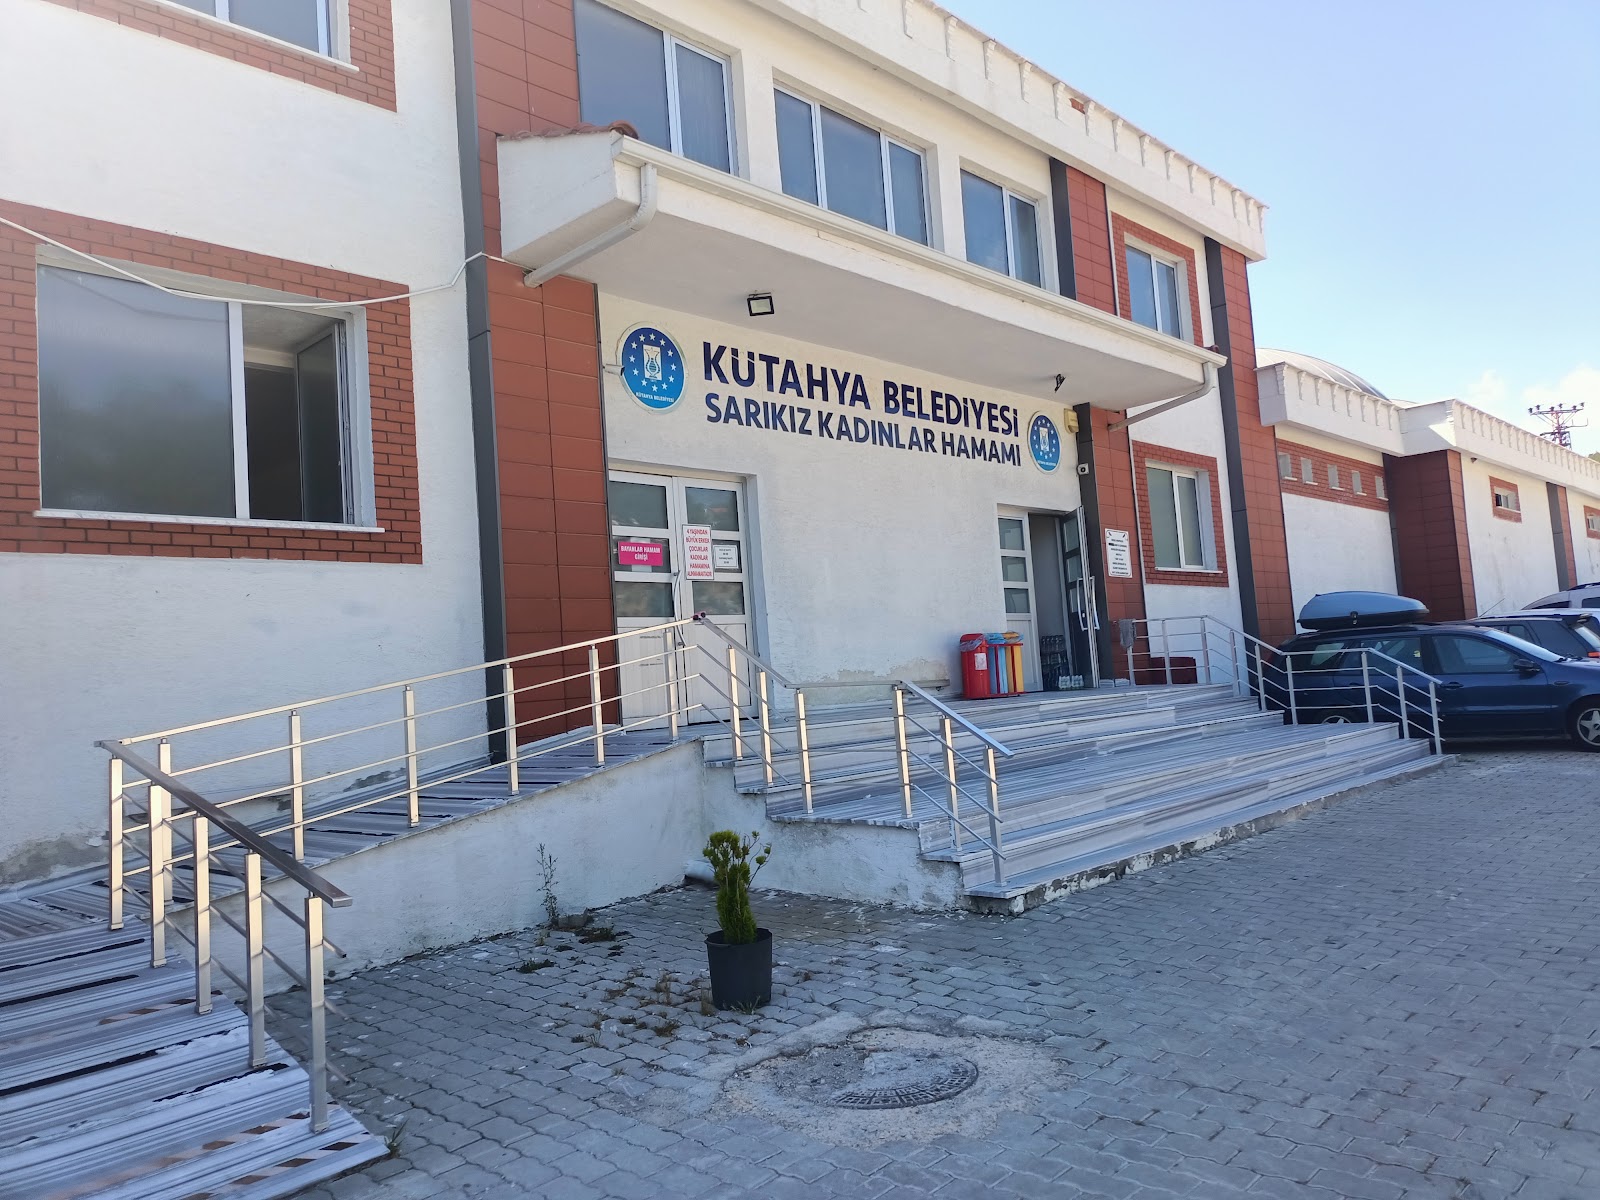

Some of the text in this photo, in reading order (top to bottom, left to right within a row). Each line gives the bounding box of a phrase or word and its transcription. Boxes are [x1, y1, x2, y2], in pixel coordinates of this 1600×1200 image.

[703, 341, 1019, 437] KÜTAHYA BELEDİYESİ
[705, 392, 1021, 466] SARIKIZ KADINLAR HAMAMI
